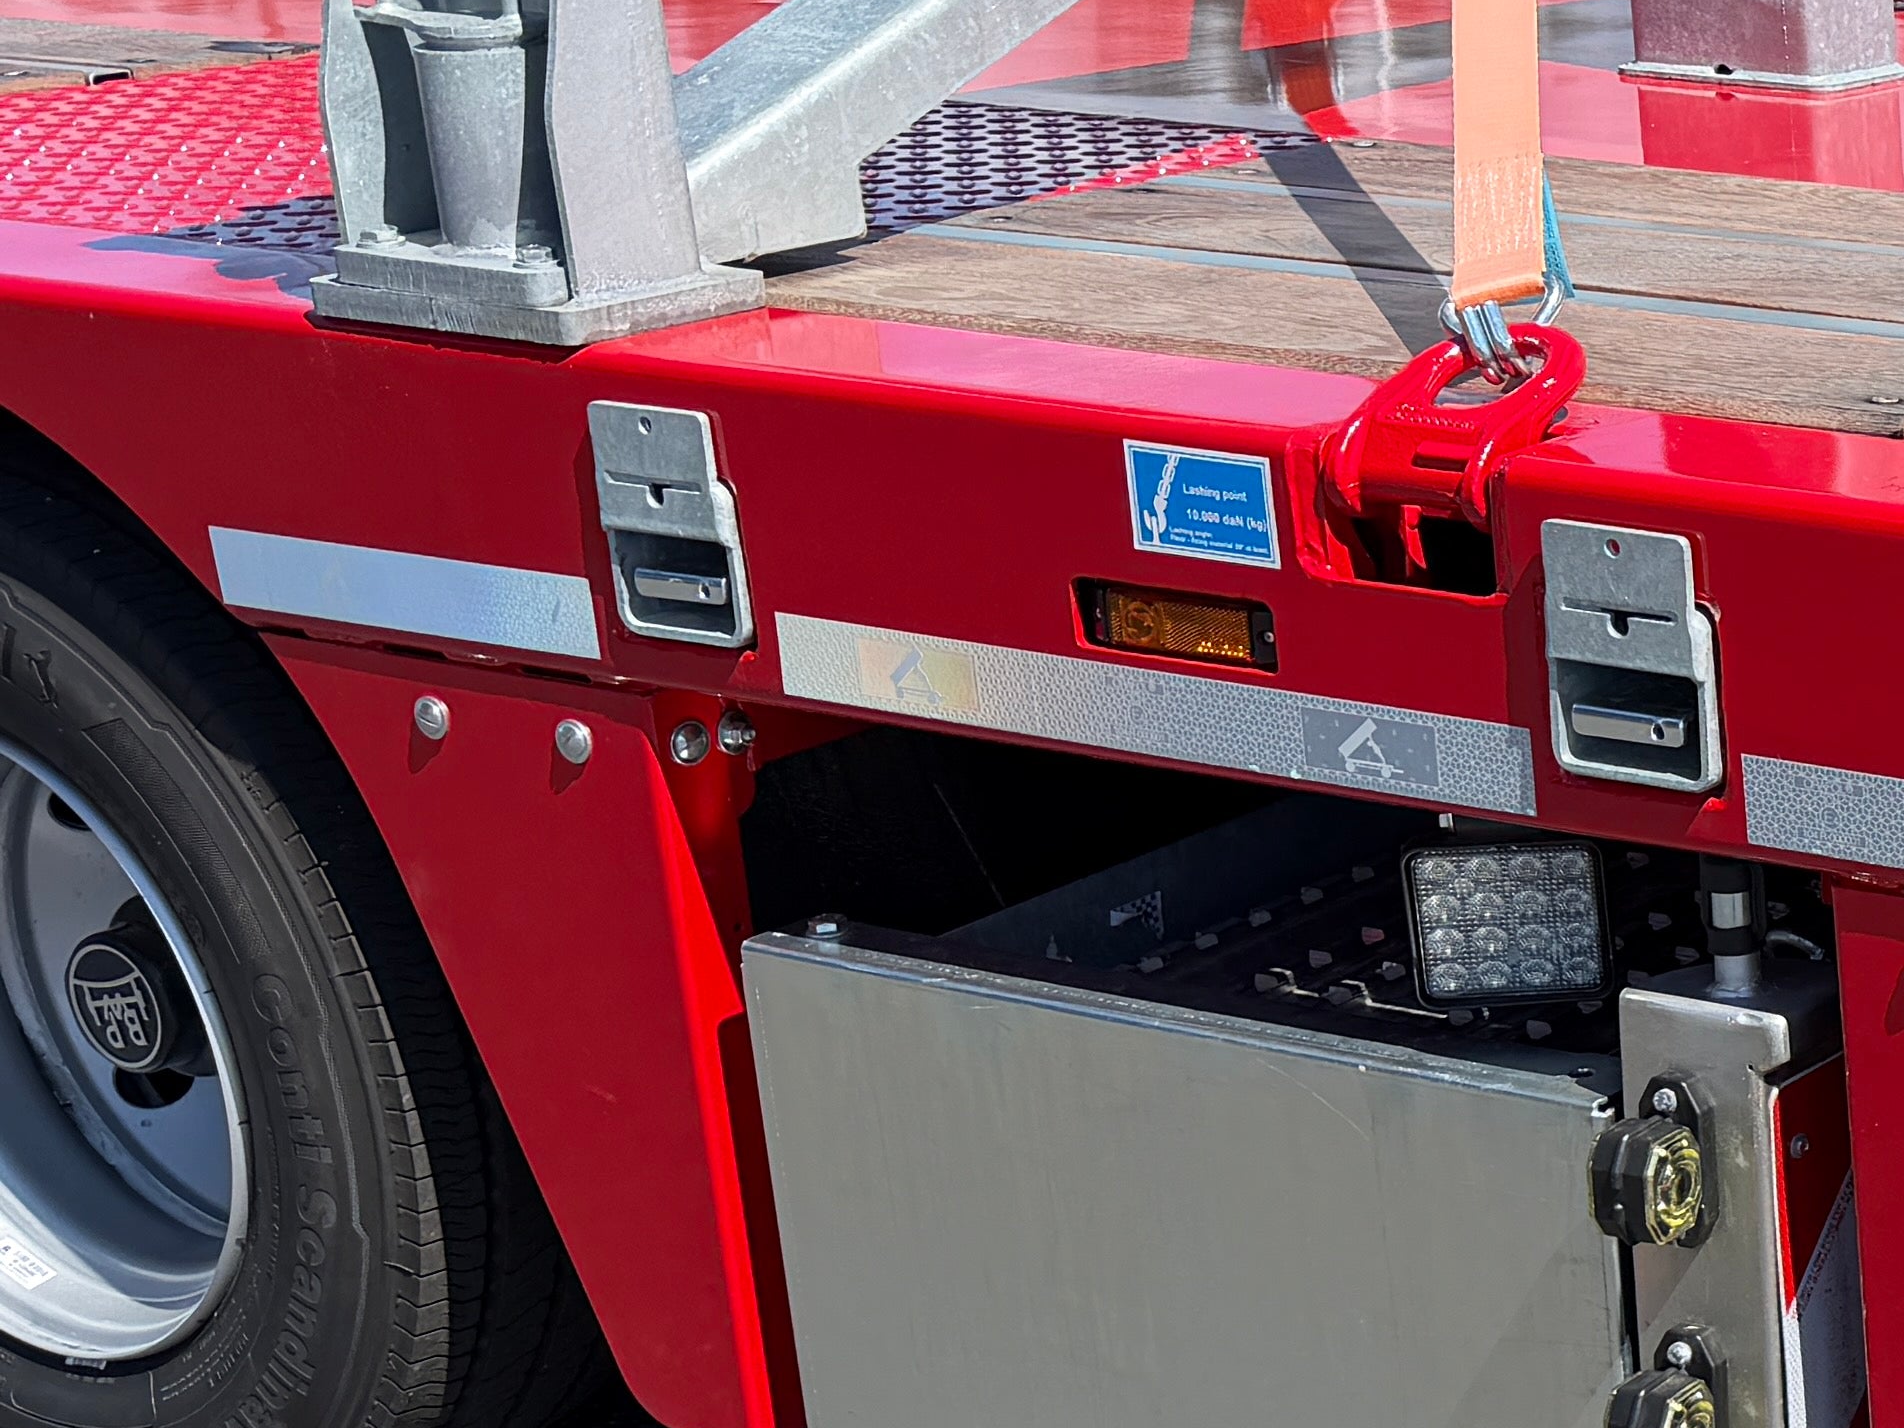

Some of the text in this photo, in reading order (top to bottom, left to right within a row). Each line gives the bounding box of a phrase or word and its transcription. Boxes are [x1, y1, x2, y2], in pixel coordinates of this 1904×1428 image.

[1182, 483, 1248, 503] Lashing point
[251, 974, 333, 1167] Conti
